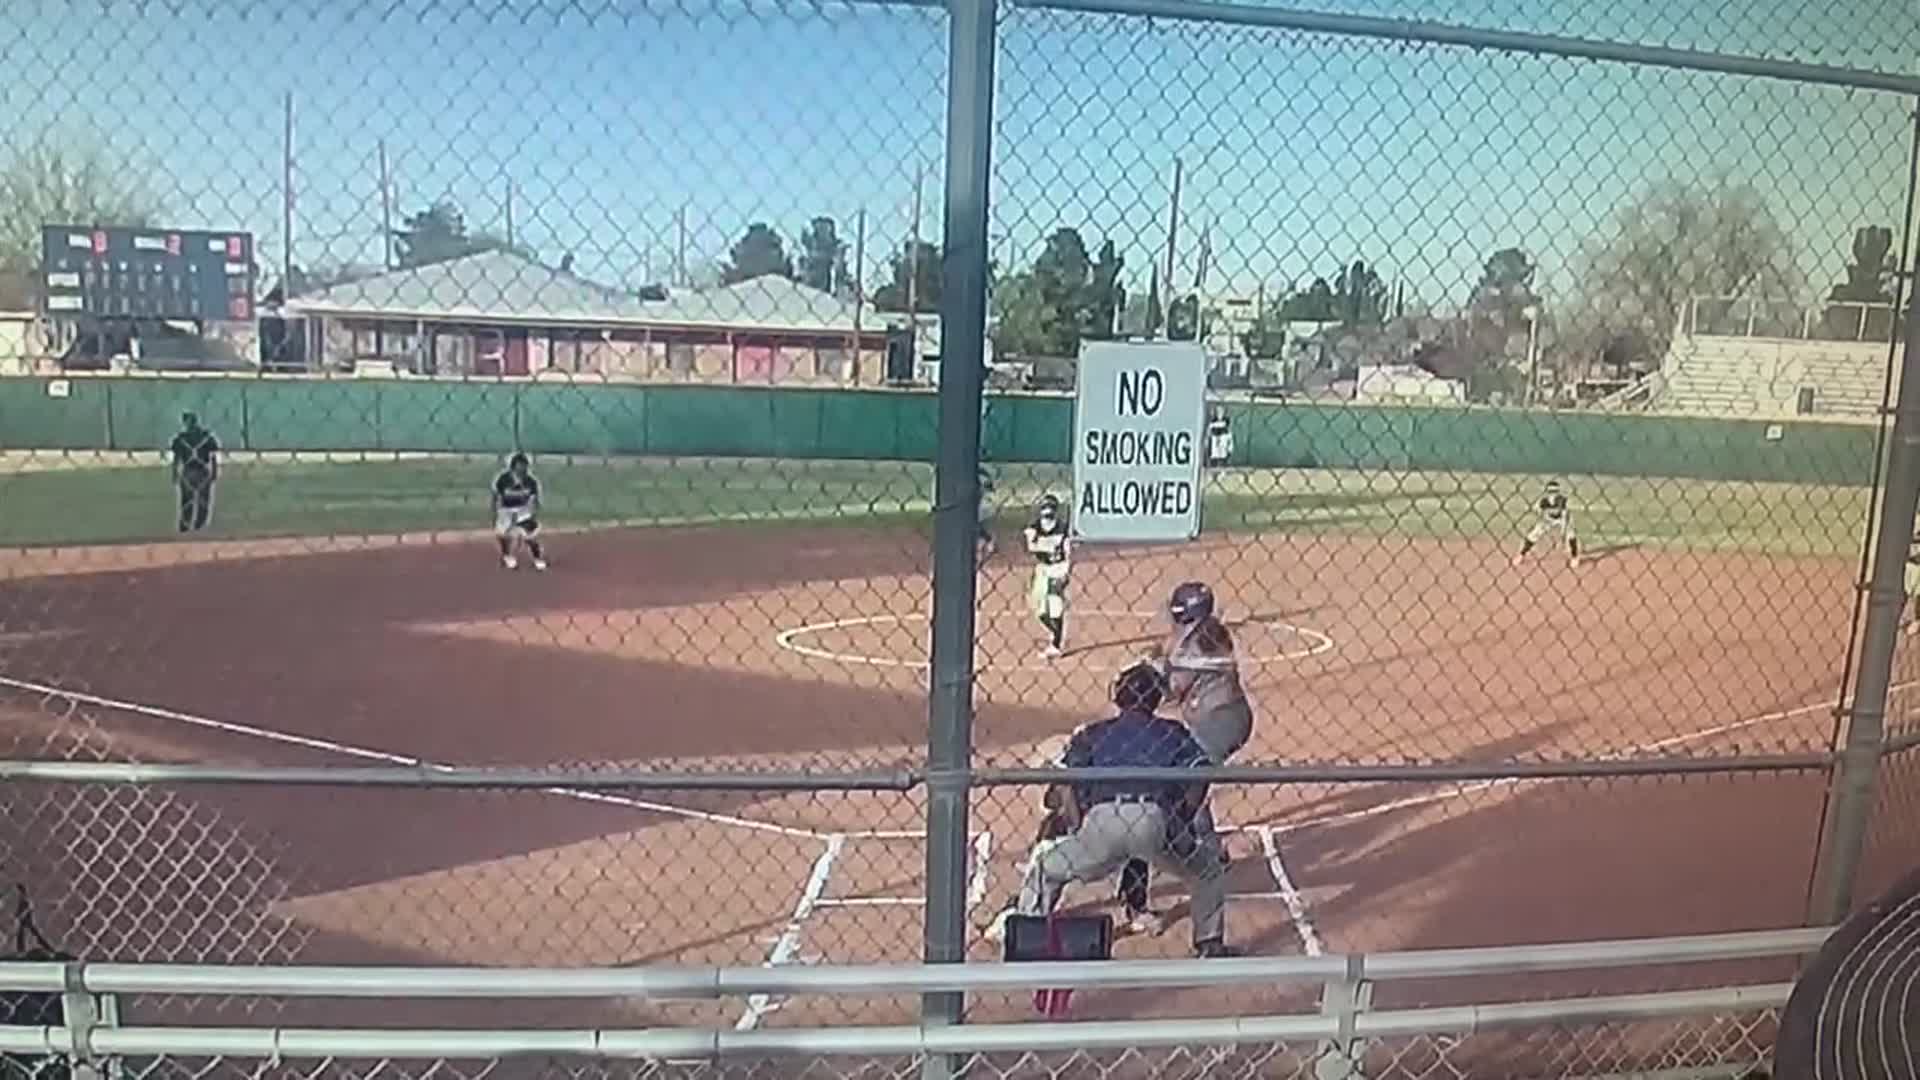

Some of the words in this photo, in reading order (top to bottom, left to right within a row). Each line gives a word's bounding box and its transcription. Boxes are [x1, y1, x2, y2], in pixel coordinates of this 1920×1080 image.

[1118, 369, 1162, 416] NO
[1086, 431, 1191, 464] SMOKING
[1080, 481, 1191, 515] ALLOWED
